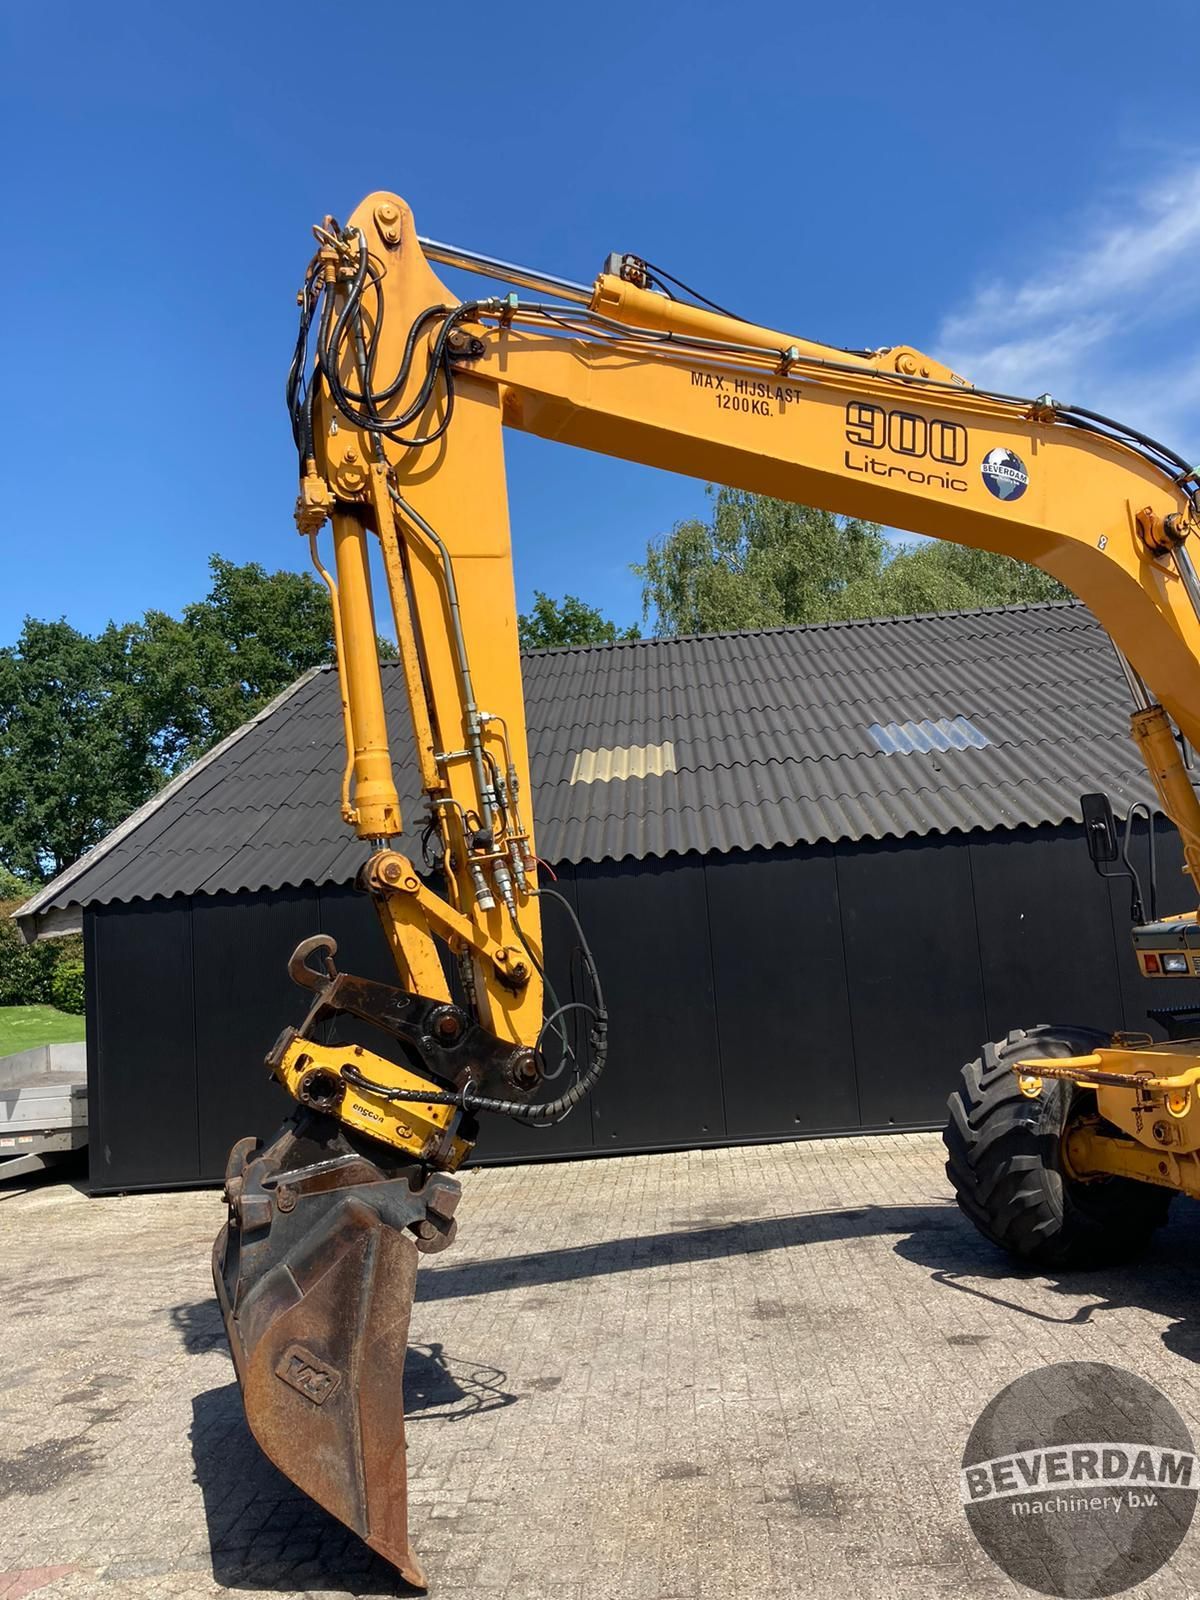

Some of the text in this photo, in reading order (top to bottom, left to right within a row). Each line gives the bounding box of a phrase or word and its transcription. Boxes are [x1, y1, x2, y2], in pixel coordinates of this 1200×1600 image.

[691, 371, 802, 404] MAX. HIJSLAST
[845, 400, 968, 467] 900
[844, 450, 968, 492] Litronic
[983, 464, 1027, 483] BEVERDAM
[352, 1103, 384, 1123] engcon
